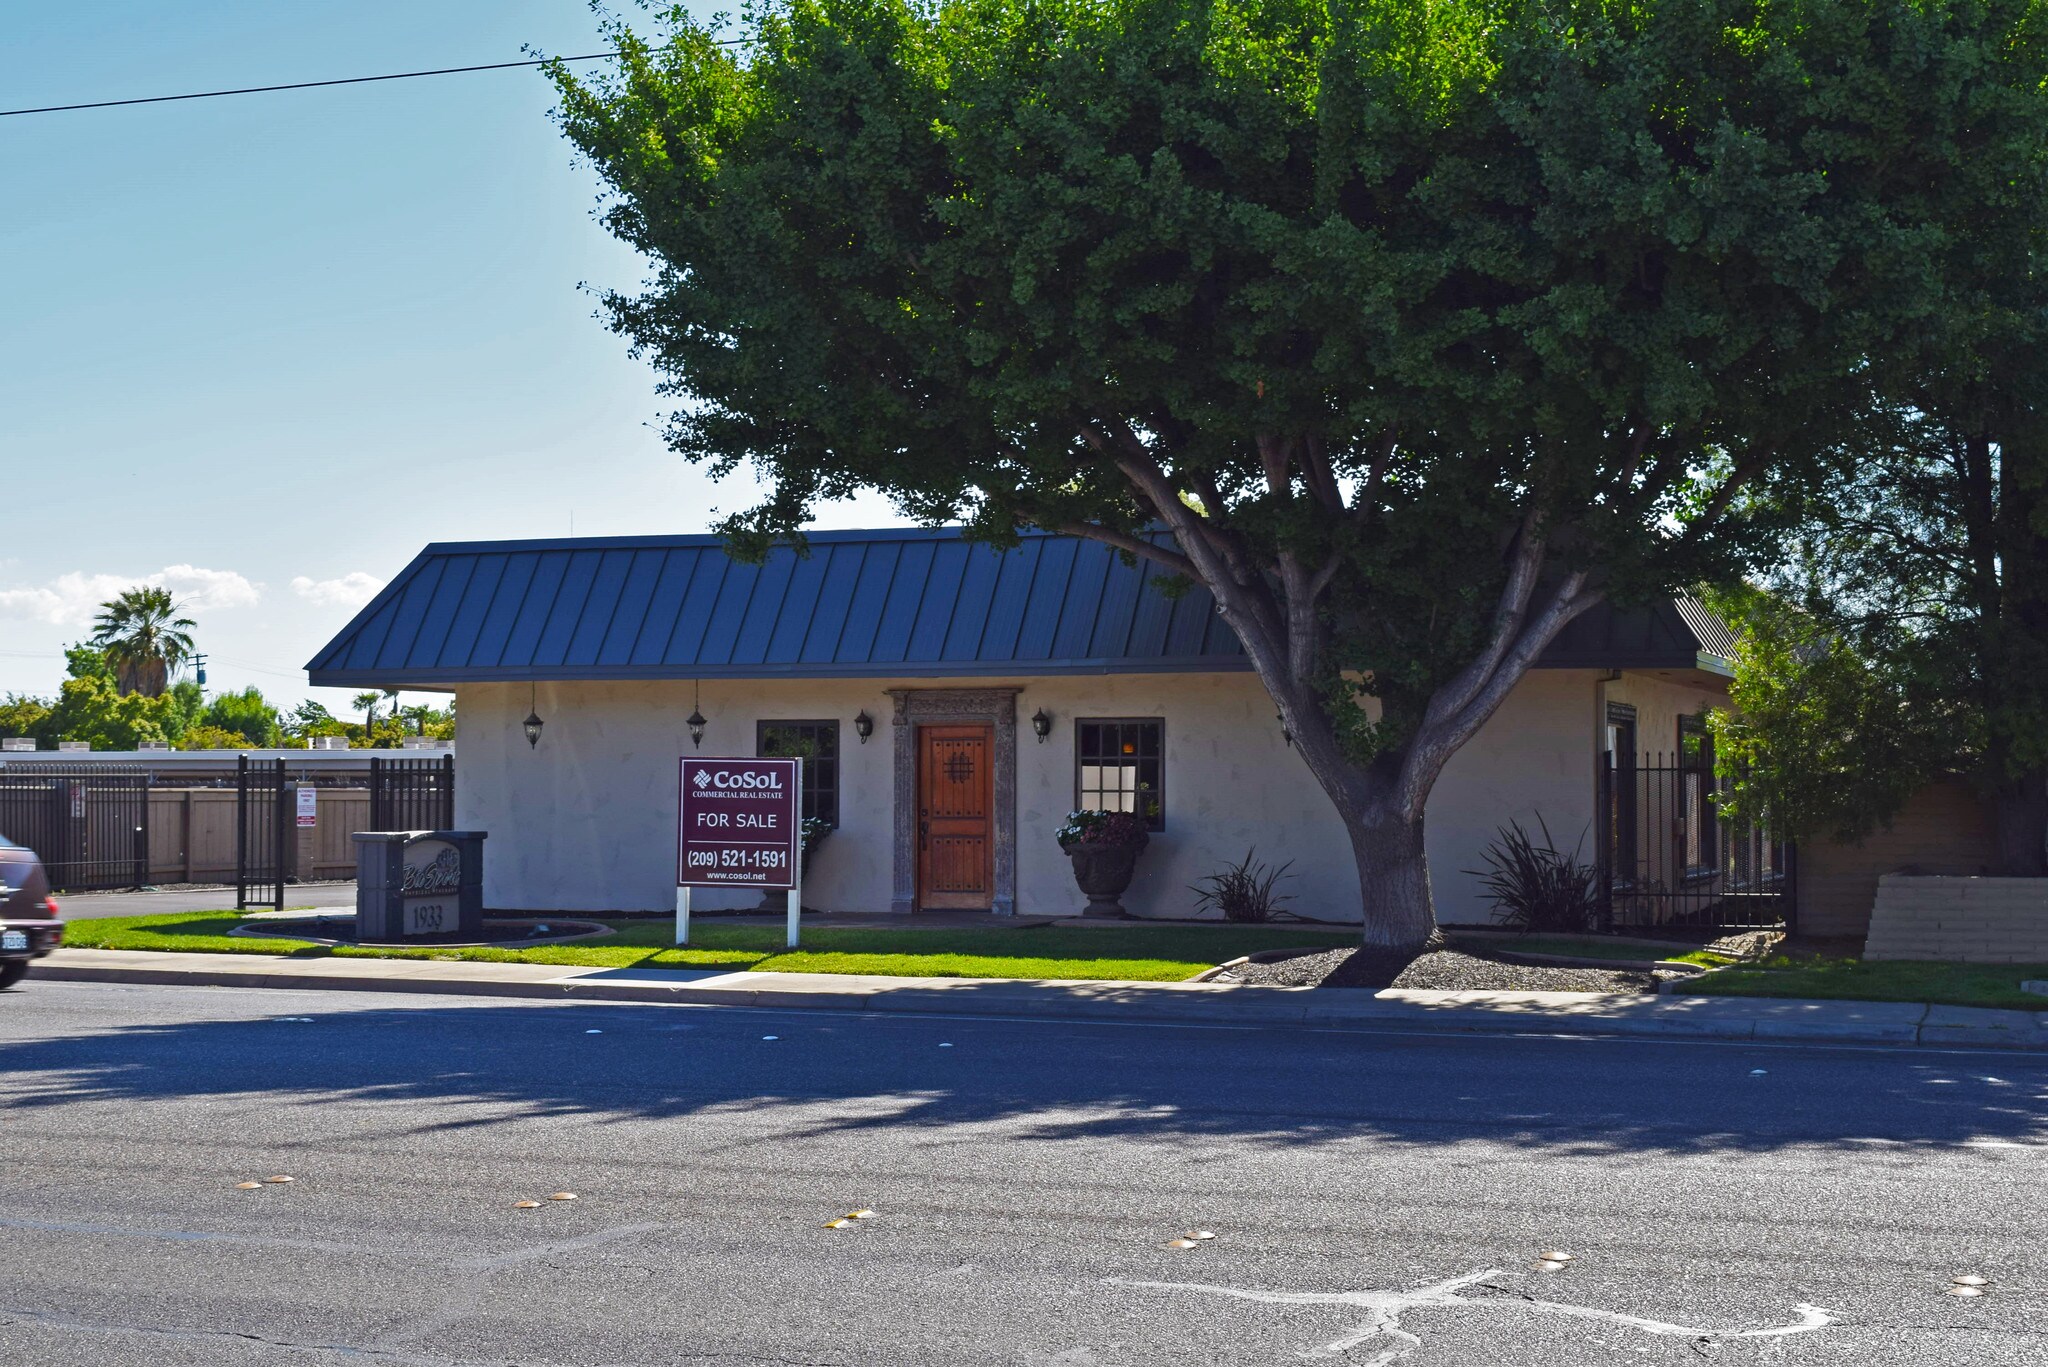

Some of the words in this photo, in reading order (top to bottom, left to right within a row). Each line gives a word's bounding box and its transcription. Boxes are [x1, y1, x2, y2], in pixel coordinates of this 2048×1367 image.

[697, 813, 729, 827] FOR
[736, 814, 777, 828] SALE
[688, 850, 718, 868] (209)
[721, 850, 786, 868] 521-1591
[707, 872, 766, 880] www.cosol.net
[414, 905, 442, 930] 1933
